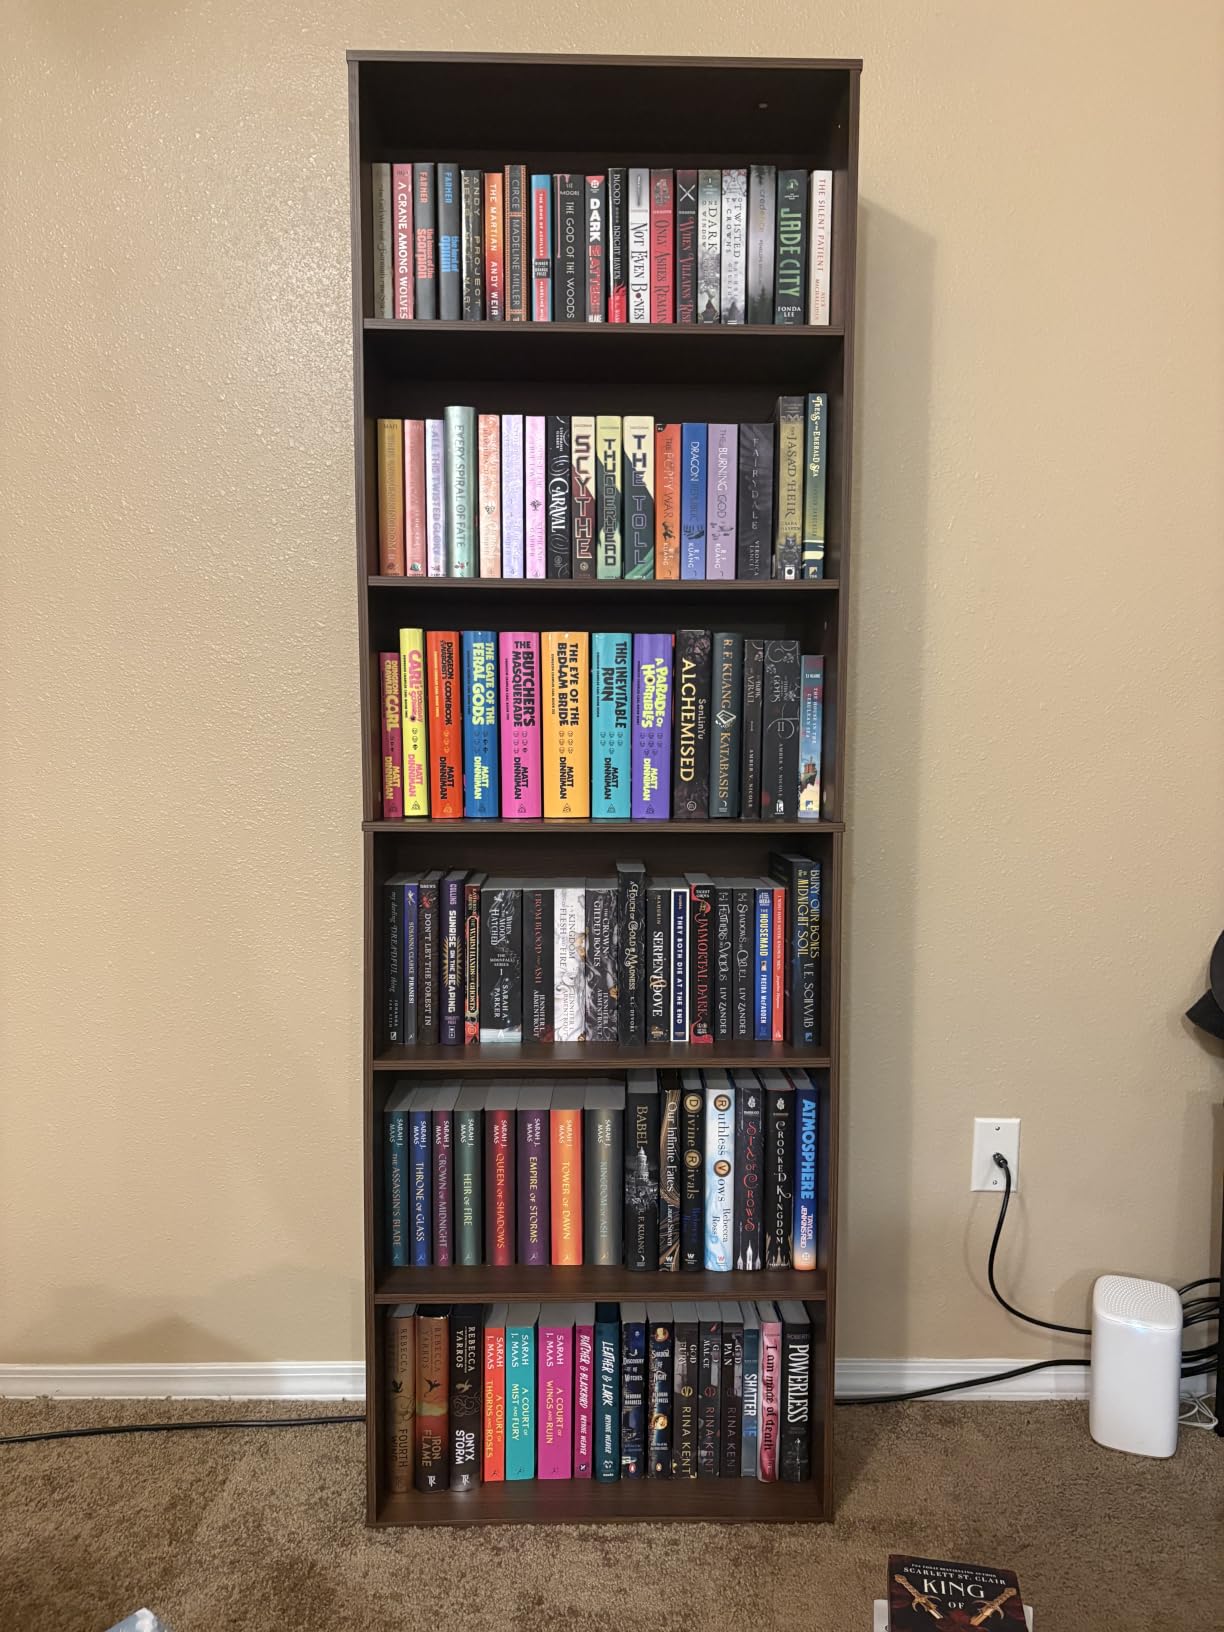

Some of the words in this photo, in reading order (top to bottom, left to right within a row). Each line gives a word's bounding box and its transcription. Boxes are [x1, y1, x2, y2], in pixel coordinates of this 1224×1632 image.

[420, 172, 428, 203] FARMER
[398, 194, 408, 228] CRANE
[566, 202, 574, 214] THE
[590, 198, 600, 242] DARK
[818, 200, 826, 230] SILENT
[512, 220, 520, 271] MADELINE
[566, 218, 574, 242] GOD
[780, 208, 802, 255] JADE
[399, 233, 408, 274] AMONG
[416, 229, 426, 279] scorpion
[440, 236, 452, 272] opium
[566, 246, 574, 258] OF
[566, 262, 574, 274] THE
[816, 235, 824, 272] PATIENT
[512, 274, 520, 306] MILLER
[778, 260, 801, 297] CITY
[400, 277, 408, 319] WOLVES
[566, 278, 575, 318] WOODS
[455, 425, 464, 460] EVERY
[632, 434, 646, 486] THE
[690, 442, 700, 482] DRAGON
[718, 448, 728, 491] BURNING
[456, 464, 466, 502] SPIRAL
[574, 436, 592, 558] SCYTHE
[456, 504, 466, 519] OF
[548, 478, 569, 532] CARAVAL
[718, 495, 728, 518] GOD
[456, 522, 466, 548] FATE
[486, 642, 494, 660] THE
[514, 641, 531, 649] THE
[570, 644, 578, 664] THE
[614, 642, 628, 665] THIS
[722, 640, 733, 649] R.
[722, 652, 732, 660] F.
[472, 642, 484, 682] FERAL
[486, 664, 494, 688] GATE
[556, 643, 568, 689] BEDLAM
[570, 667, 579, 684] EYE
[486, 694, 494, 705] OF
[512, 651, 522, 728] MASQUERADE
[522, 651, 535, 727] BUTCHER'S
[570, 688, 578, 704] OF
[600, 667, 614, 702] RUIN
[614, 667, 628, 729] INEVITABLE
[641, 664, 656, 728] HORRIBLES
[654, 666, 668, 716] PARADE
[722, 663, 732, 709] KUANG
[386, 695, 400, 731] CARL
[472, 683, 484, 725] GODS
[486, 708, 495, 725] THE
[558, 693, 568, 726] BRIDE
[570, 708, 579, 726] THE
[680, 658, 696, 782] ALCHEMISED
[656, 718, 664, 728] OF
[643, 758, 651, 801] DINNIMAN
[719, 732, 731, 798] KATABASIS
[810, 870, 820, 896] BURY
[798, 879, 808, 926] MIDNIGHT
[810, 898, 820, 922] OUR
[760, 914, 768, 956] HOUSEMAID
[798, 930, 808, 958] SOIL
[810, 925, 820, 959] BONES
[676, 978, 682, 988] AT
[424, 1016, 432, 1026] IN
[636, 1106, 648, 1148] BABEL
[667, 1102, 678, 1124] Our
[714, 1094, 732, 1156] Ruthless
[667, 1126, 678, 1163] Infinite
[801, 1099, 816, 1200] ATMOSPHERE
[416, 1162, 424, 1200] THRONE
[438, 1153, 447, 1190] CROWN
[464, 1173, 472, 1195] HEIR
[495, 1153, 504, 1186] QUEEN
[530, 1156, 538, 1190] EMPIRE
[666, 1166, 677, 1192] Fates
[714, 1160, 732, 1202] Vows
[416, 1213, 424, 1242] GLASS
[439, 1202, 448, 1248] MIDNIGHT
[464, 1208, 472, 1226] FIRE
[496, 1202, 505, 1248] SHADOWS
[530, 1205, 538, 1244] STORMS
[722, 1208, 731, 1242] Rebecca
[468, 1326, 476, 1372] REBECCA
[602, 1341, 615, 1374] LEATHER
[766, 1354, 776, 1372] am
[602, 1384, 613, 1406] LARK
[744, 1374, 758, 1416] SHATTER
[766, 1375, 777, 1404] made
[788, 1344, 810, 1422] POWERLESS
[682, 1406, 690, 1436] RINA
[766, 1406, 778, 1418] of
[421, 1430, 431, 1467] FLAME
[432, 1436, 442, 1460] IRON
[455, 1430, 464, 1464] STORM
[465, 1432, 474, 1462] ONYX
[764, 1419, 777, 1451] death
[682, 1442, 691, 1474] KENT
[903, 1566, 955, 1579] SCARLETT
[958, 1573, 972, 1581] ST.
[974, 1575, 1006, 1585] CLAIR
[923, 1578, 985, 1599] KING
[948, 1601, 965, 1610] OF
